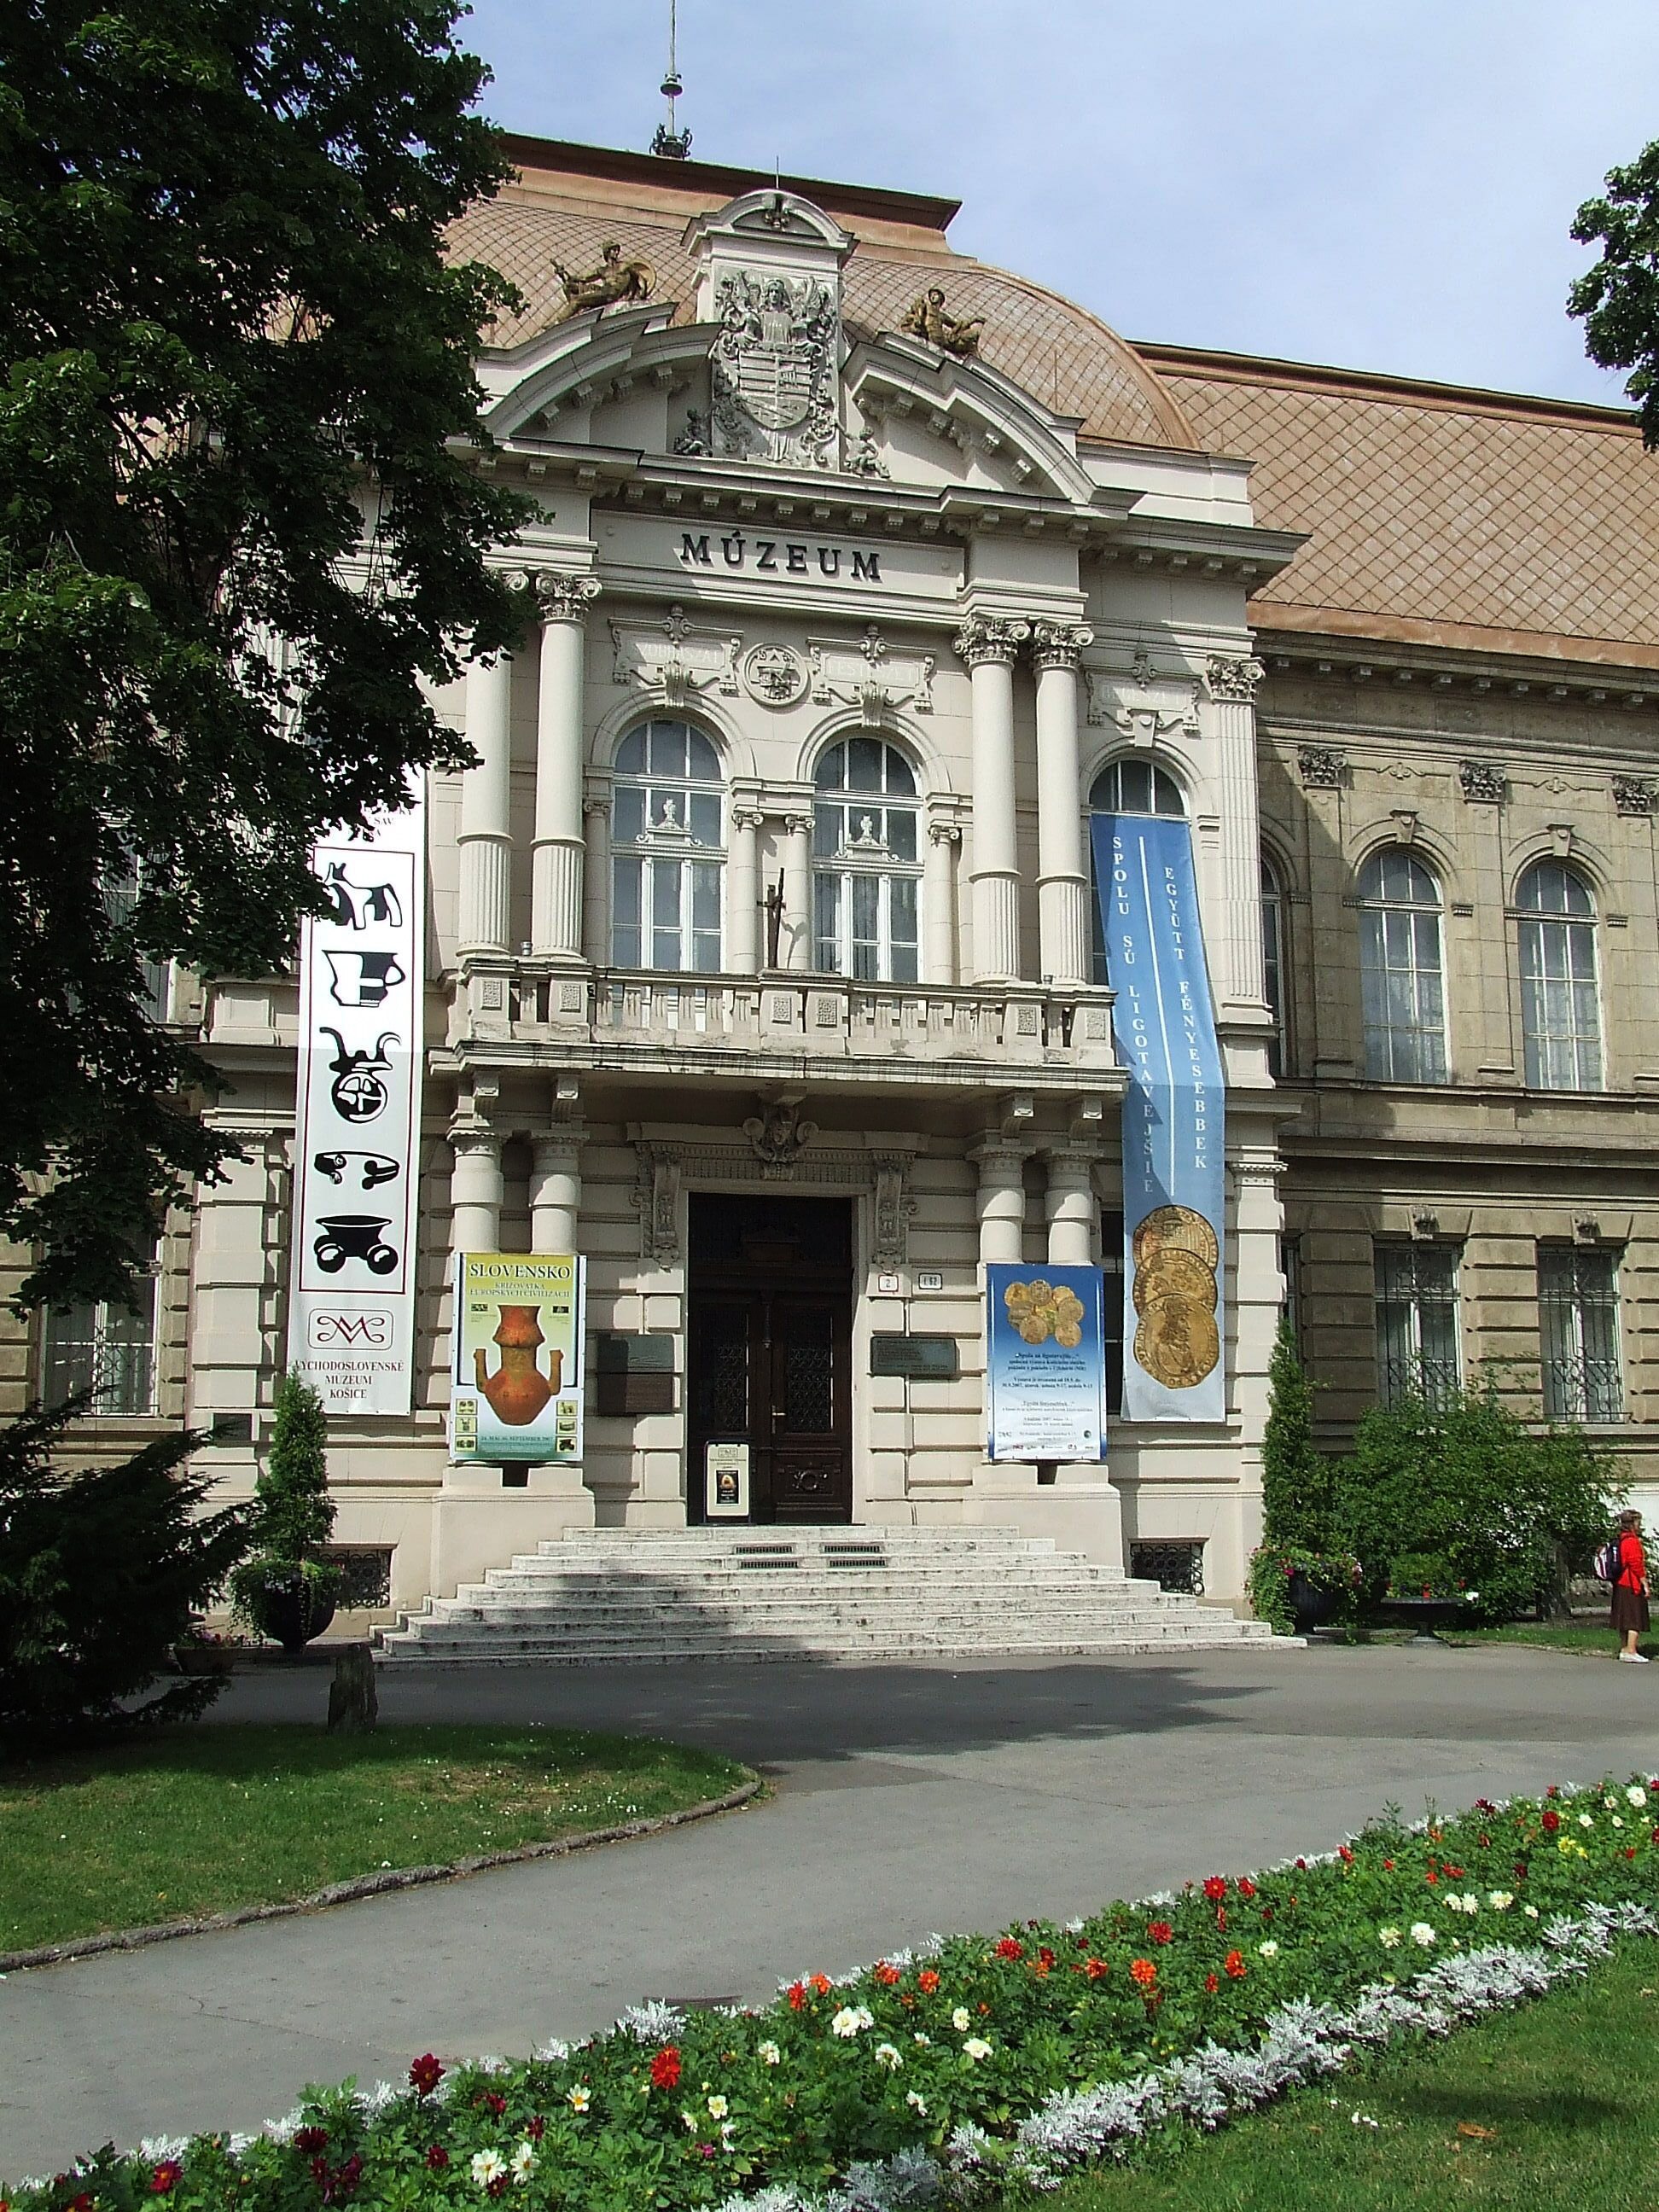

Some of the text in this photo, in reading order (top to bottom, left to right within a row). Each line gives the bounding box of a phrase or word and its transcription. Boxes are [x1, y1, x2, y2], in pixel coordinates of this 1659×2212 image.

[680, 530, 881, 581] MÚZEUM
[1112, 836, 1155, 1193] SPOLU SÚ LIGOTAVEJŠIE
[1163, 866, 1208, 1169] EGYÜTT FÉNYESEBBEK
[470, 1263, 571, 1279] SLOVENSKO
[885, 1278, 891, 1289] 2
[330, 1387, 367, 1399] KOŠICE
